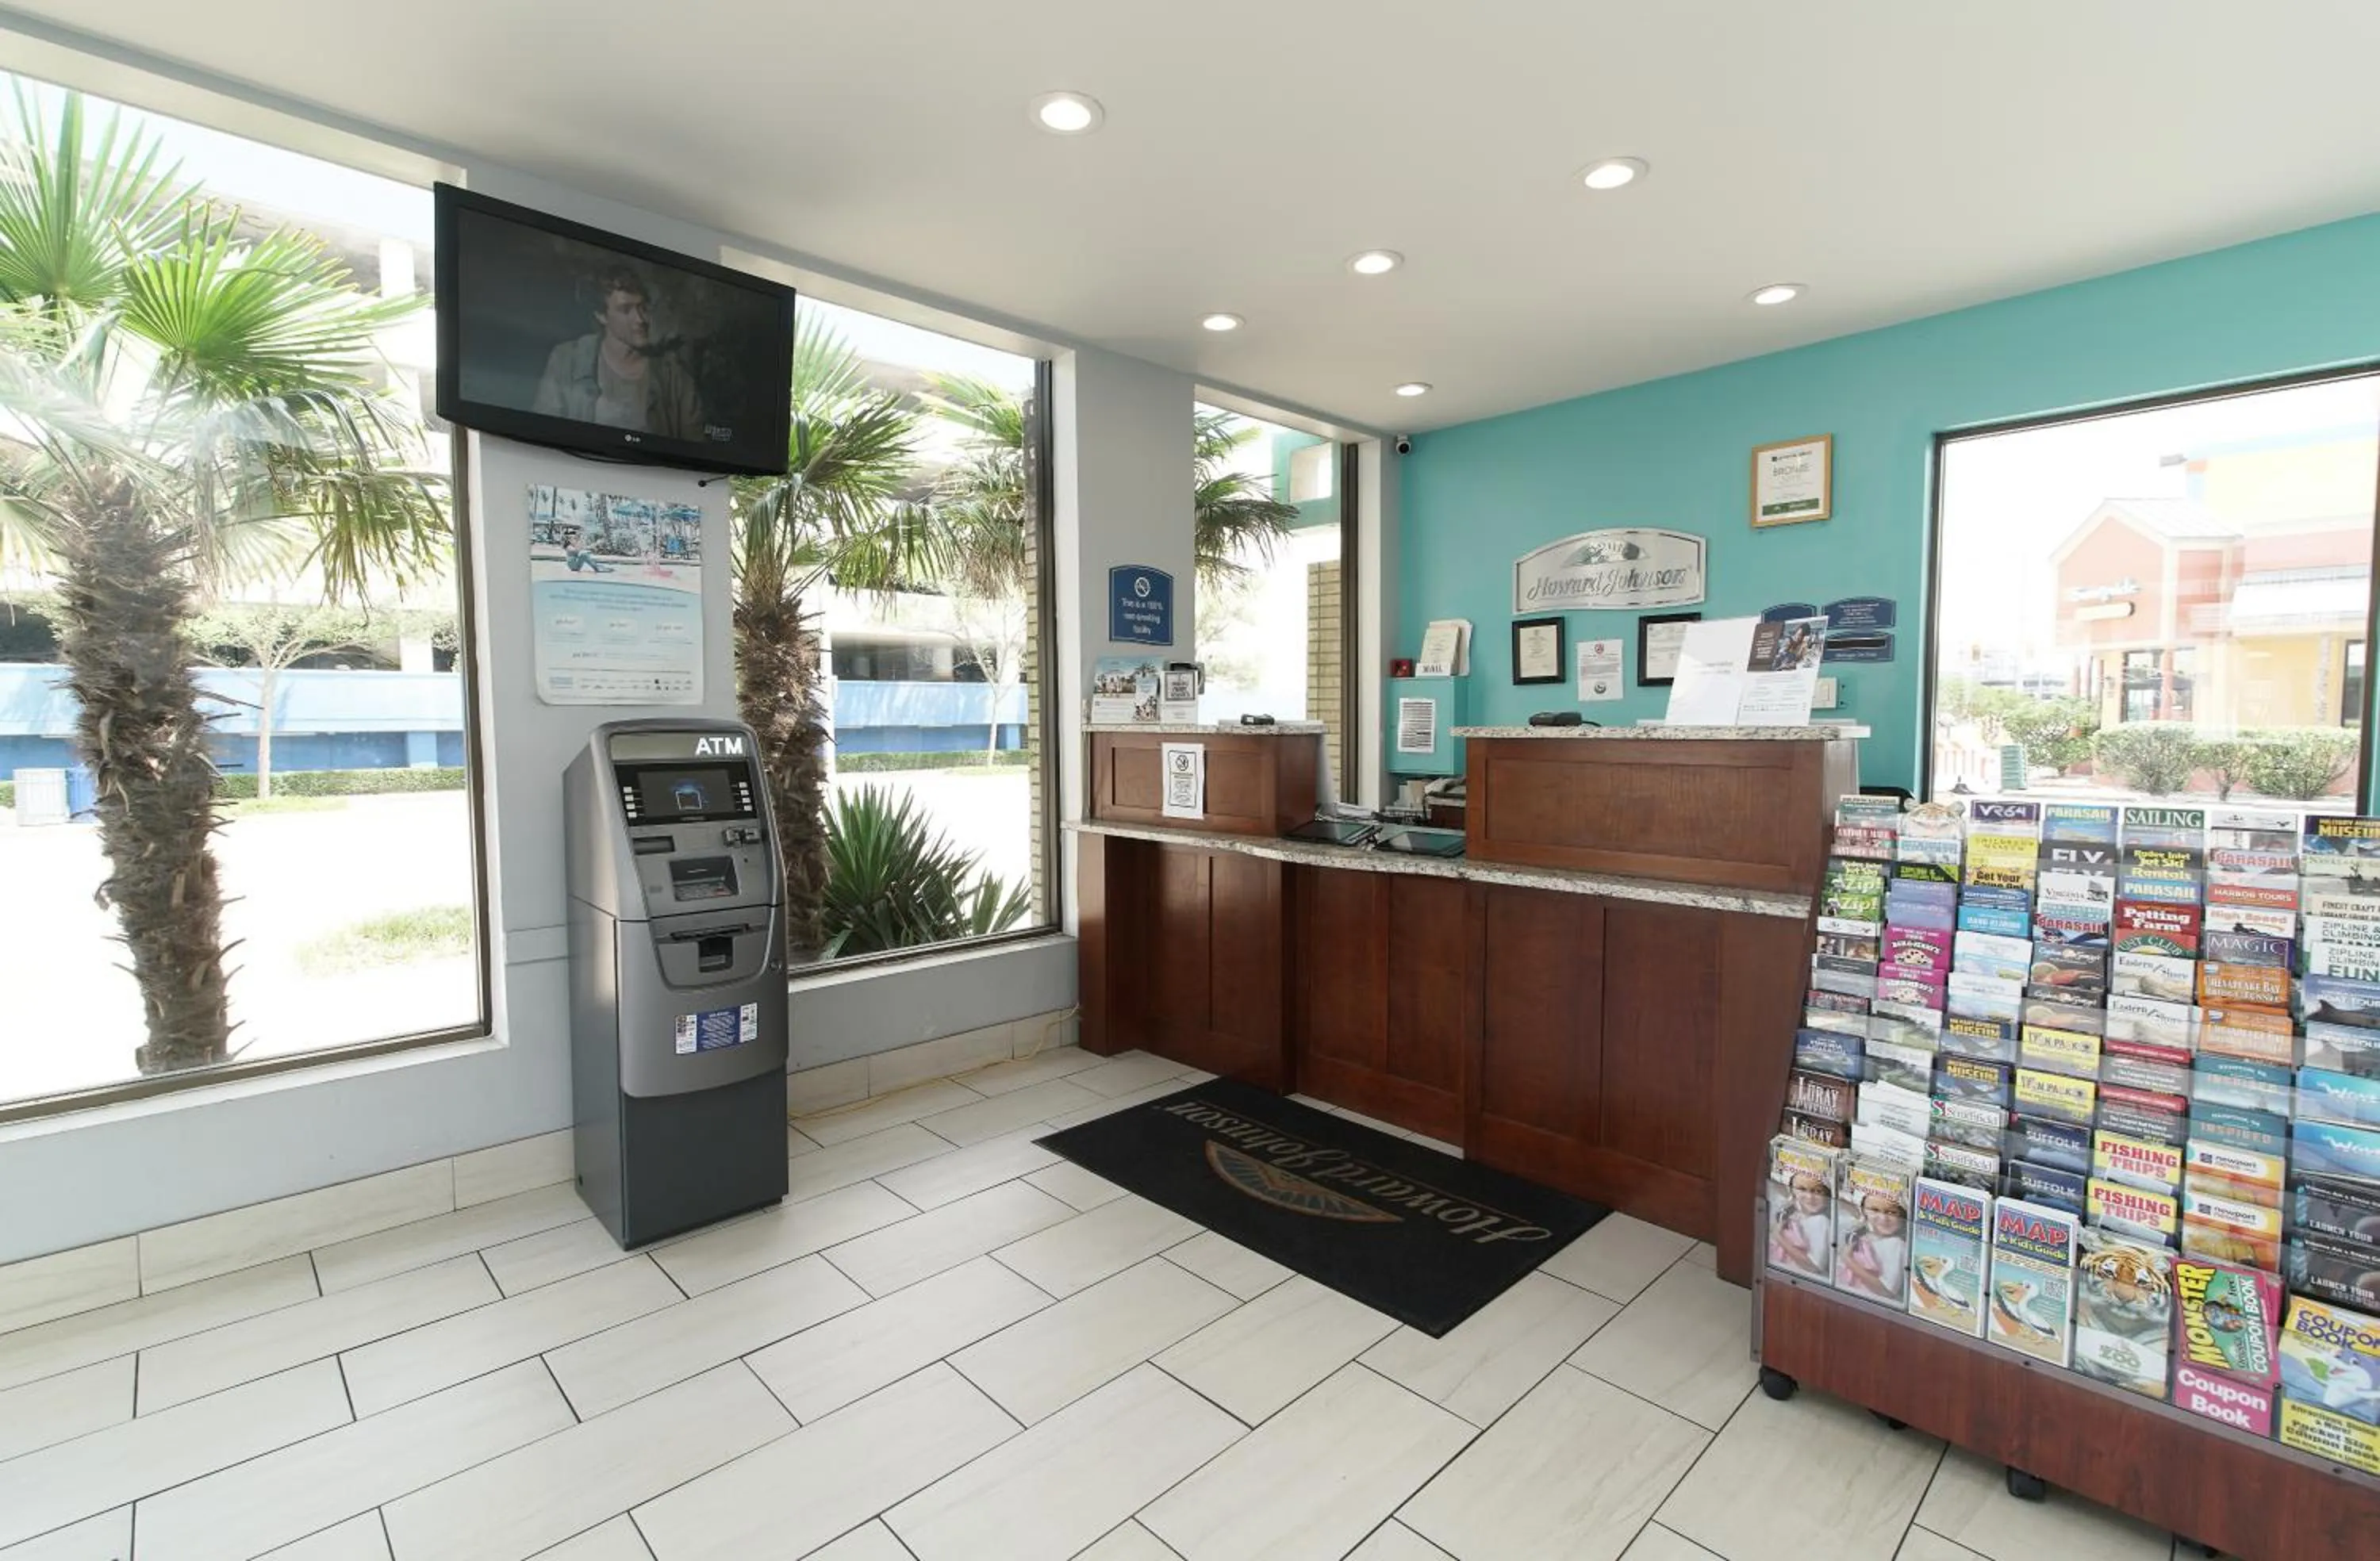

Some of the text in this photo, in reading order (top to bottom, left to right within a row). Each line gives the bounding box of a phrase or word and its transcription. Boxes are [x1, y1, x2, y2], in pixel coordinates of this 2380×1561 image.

[1526, 567, 1687, 600] Howard Johnson
[695, 737, 743, 755] ATM
[2126, 808, 2202, 828] SAILING
[2319, 823, 2380, 838] MUSEU
[1976, 871, 2021, 883] Get Your
[2124, 882, 2196, 899] PARASAIL
[2258, 892, 2293, 903] TOURS
[1839, 896, 1881, 913] Zip!
[2132, 917, 2182, 932] Farm
[2209, 936, 2285, 955] MAGIC
[2025, 1130, 2081, 1152] SUFFOLK
[2100, 1140, 2178, 1168] FISHING
[1165, 1100, 1553, 1244] Howard Johnson
[2109, 1155, 2167, 1179] TRIPS
[2020, 1175, 2076, 1198] SUFFOLK
[1918, 1191, 1982, 1221] MAP
[1918, 1210, 1926, 1220] &
[2094, 1187, 2171, 1218] FISHING
[2102, 1202, 2160, 1228] TRIPS
[1998, 1210, 2068, 1246] MAP
[1999, 1233, 2008, 1243] &
[2034, 1245, 2068, 1260] Guide
[2176, 1262, 2232, 1371] MONSTER
[2240, 1277, 2268, 1374] COUPON BOOK
[2296, 1319, 2354, 1350] BOOK
[2177, 1368, 2268, 1413] Coupon
[2190, 1393, 2252, 1429] Book
